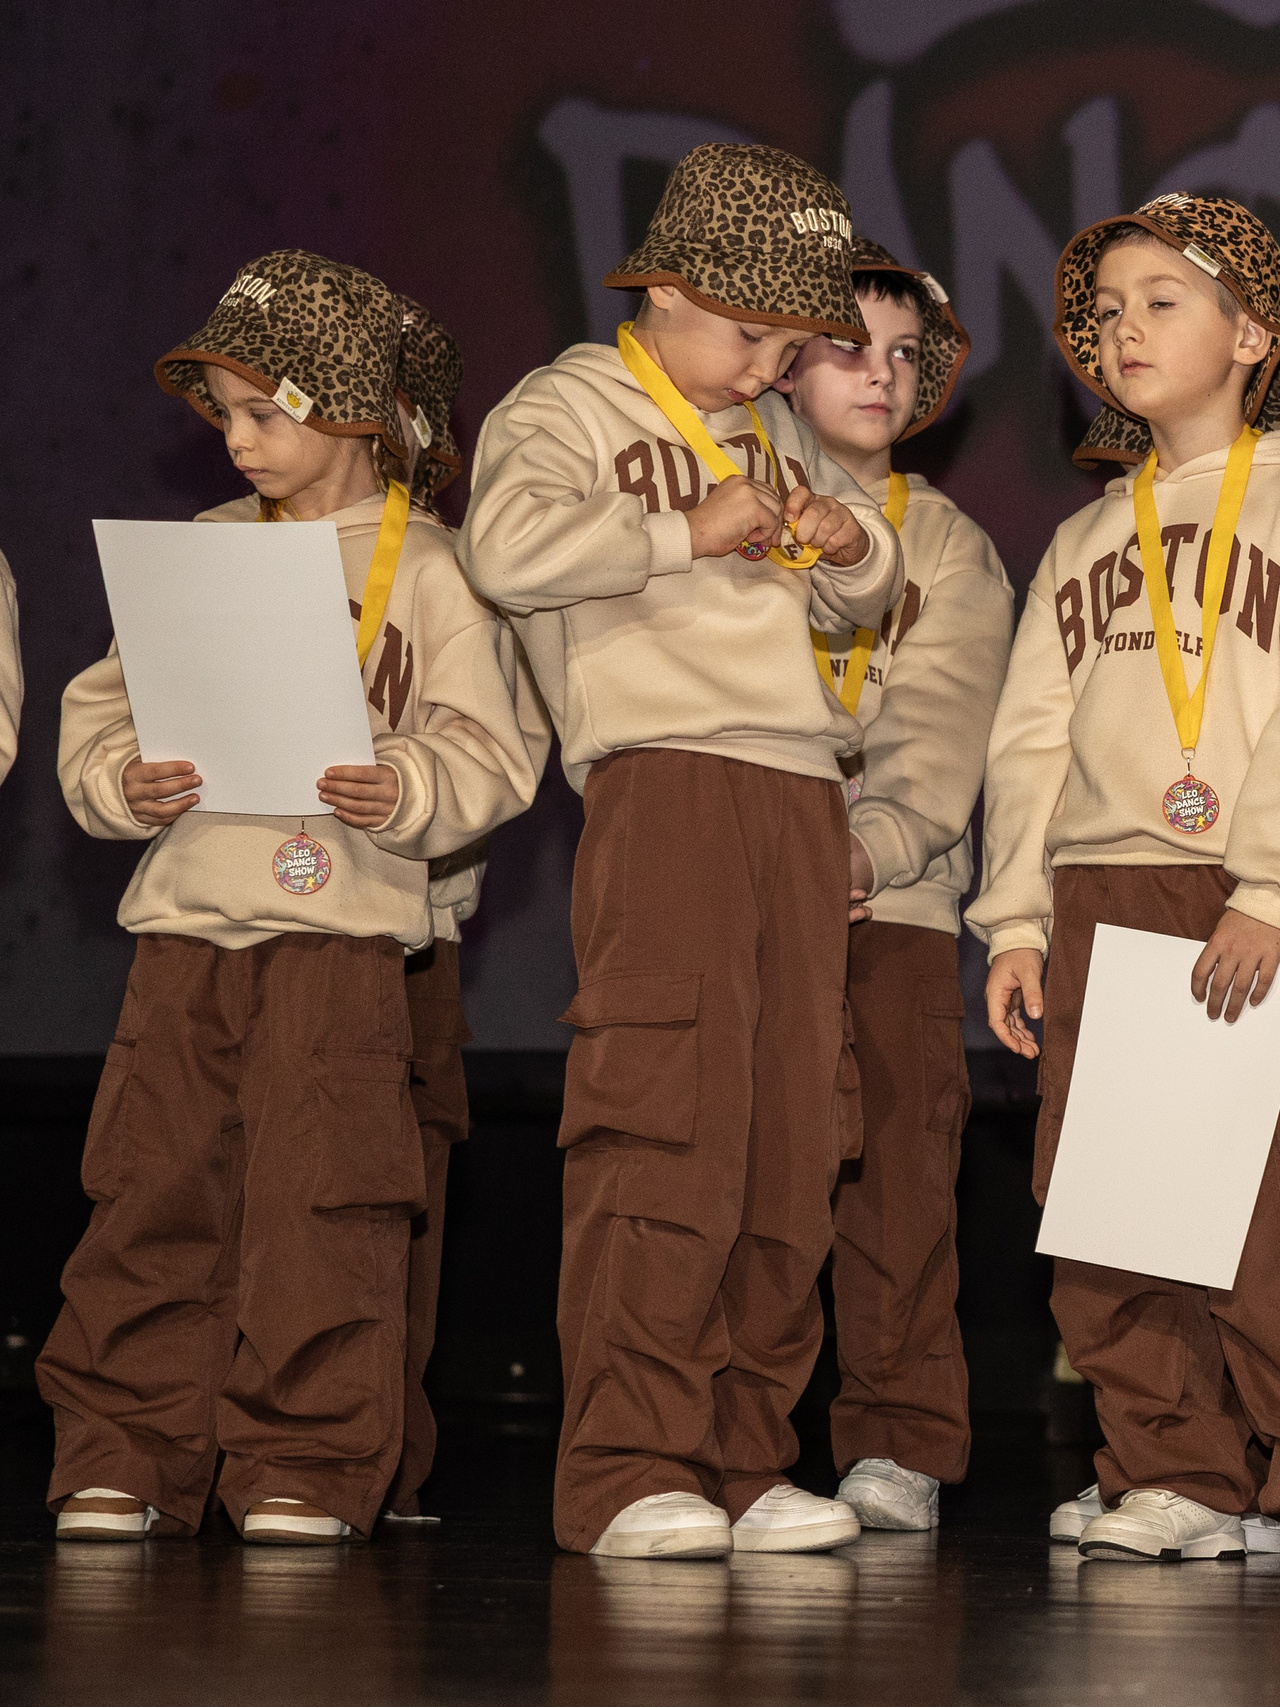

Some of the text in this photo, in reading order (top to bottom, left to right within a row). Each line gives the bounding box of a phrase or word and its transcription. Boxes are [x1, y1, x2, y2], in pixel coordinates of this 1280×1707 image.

[1095, 630, 1156, 660] YOND
[1181, 789, 1198, 799] LEO
[1175, 796, 1206, 809] DANCE
[1179, 805, 1204, 817] SHOW
[293, 848, 310, 858] LEO
[286, 856, 317, 868] DANCE
[288, 866, 315, 876] SHOW
